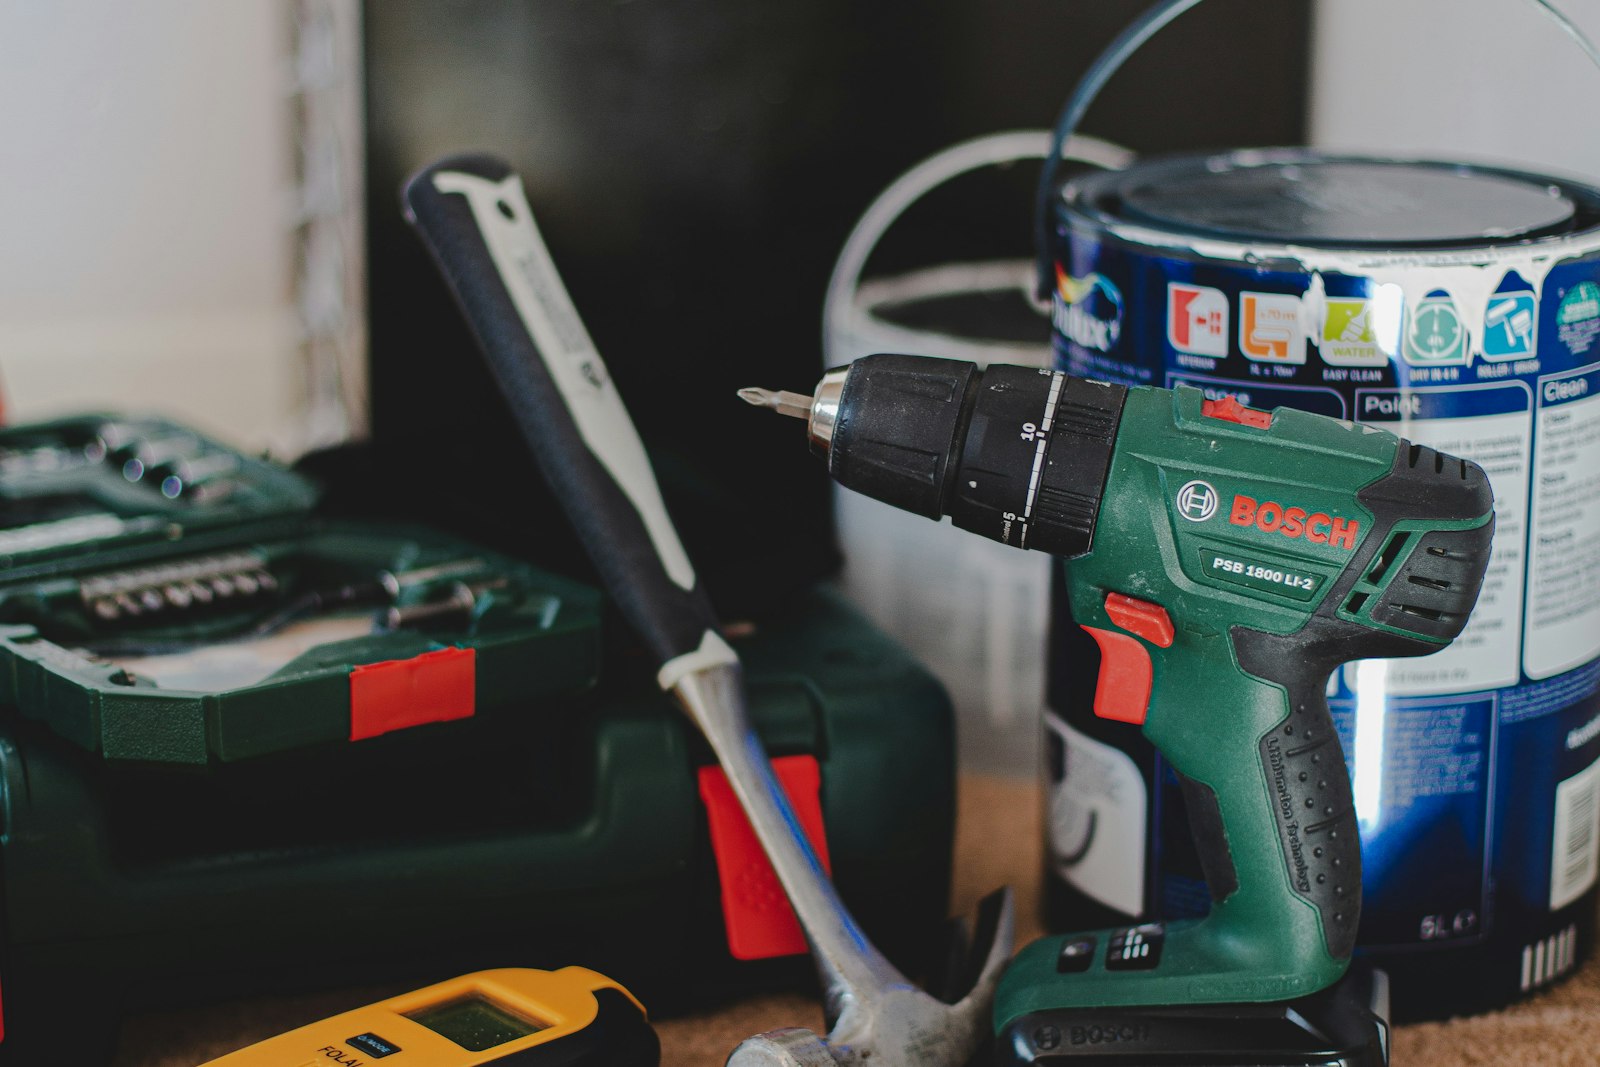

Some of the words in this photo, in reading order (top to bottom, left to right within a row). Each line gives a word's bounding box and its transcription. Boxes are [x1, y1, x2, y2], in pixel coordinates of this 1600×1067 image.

[1333, 346, 1376, 357] WATER
[1322, 368, 1348, 380] EASY
[1350, 369, 1382, 381] CLEAN
[1544, 378, 1588, 402] Clean
[1365, 394, 1420, 415] Paint
[1020, 422, 1036, 442] 10
[1229, 494, 1359, 550] BOSCH
[1213, 557, 1244, 574] PSB
[1245, 565, 1282, 583] 1800
[1284, 574, 1315, 590] LI-2
[1286, 821, 1311, 893] Technology
[1071, 1024, 1150, 1046] BOSCH
